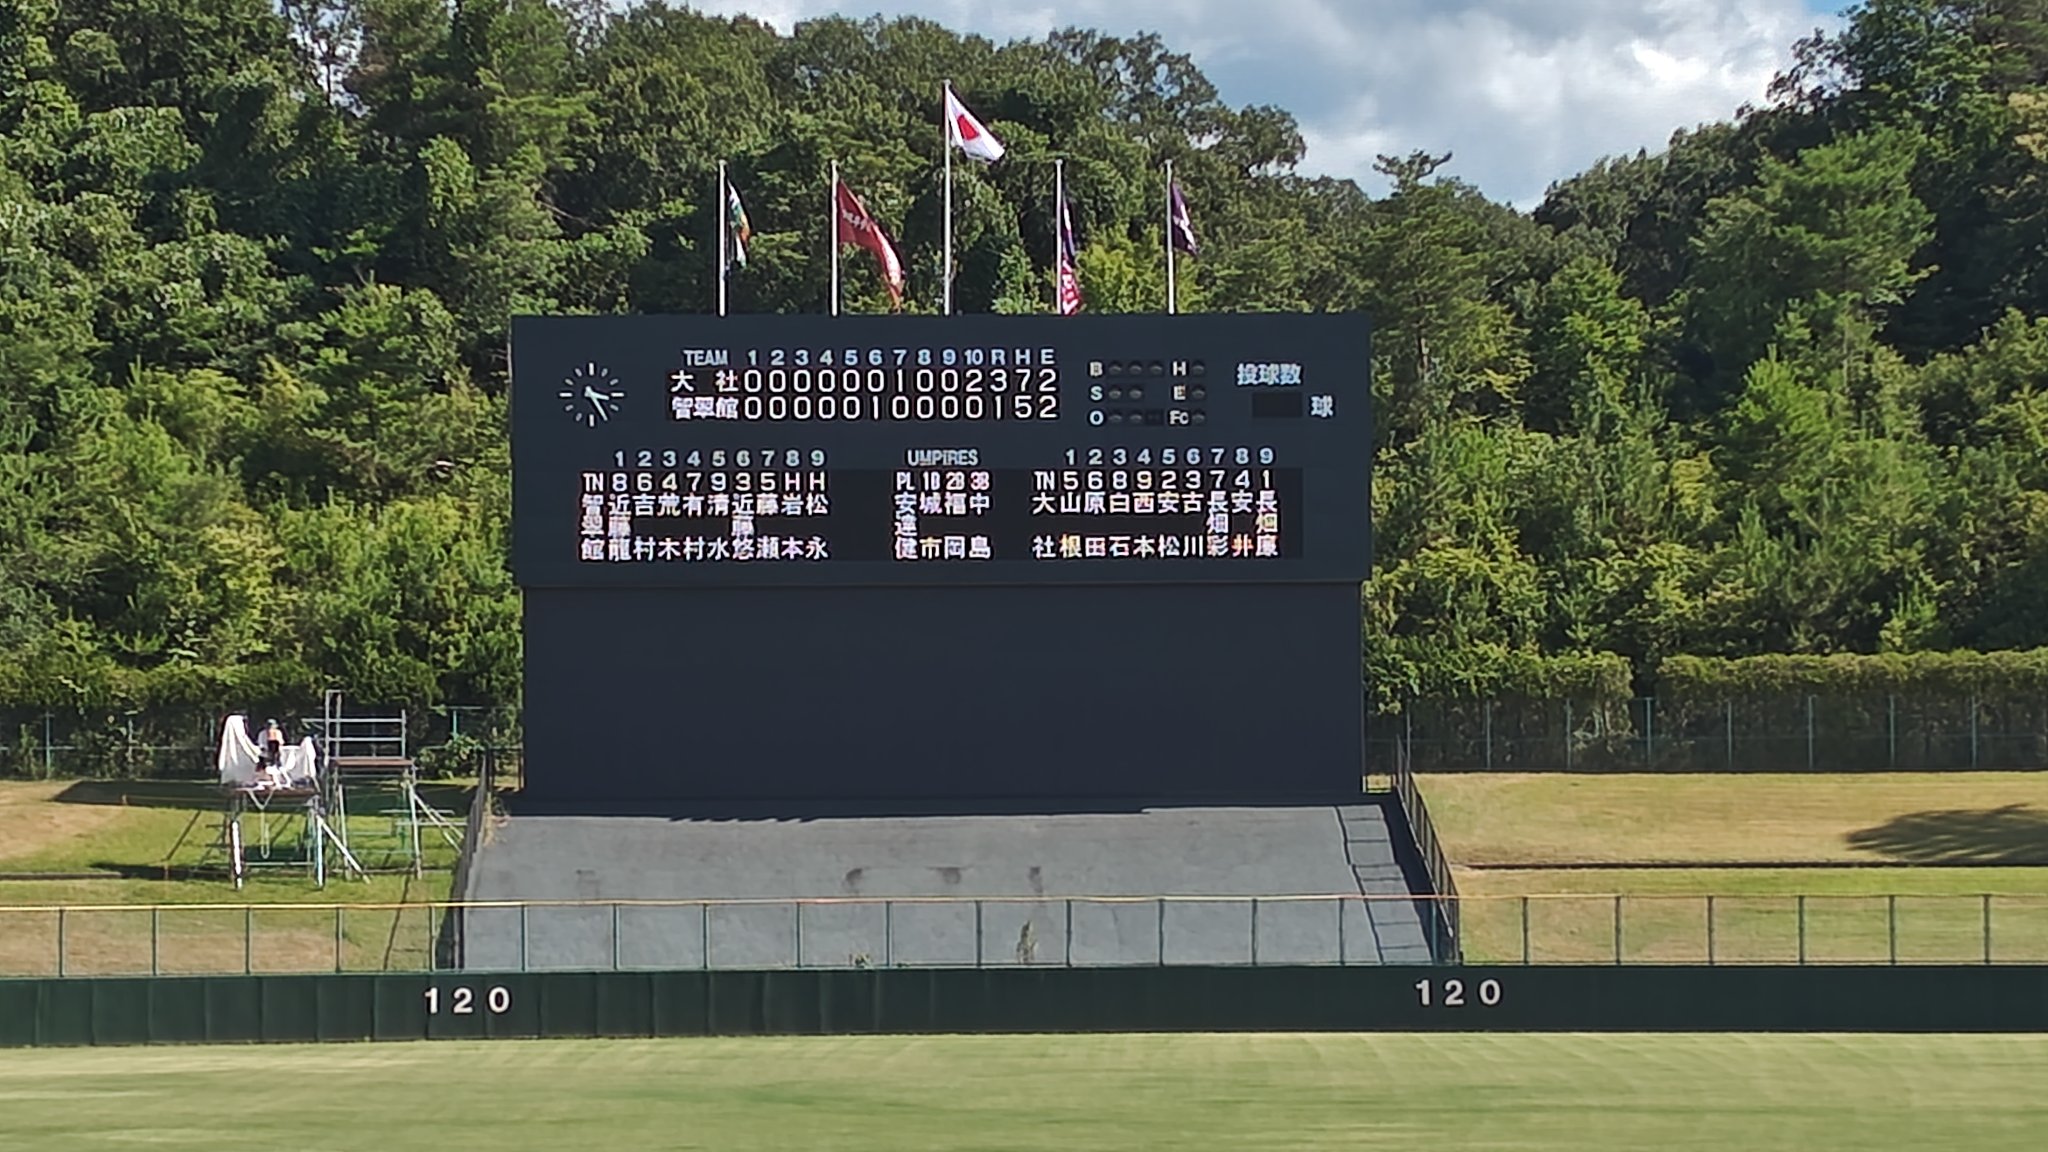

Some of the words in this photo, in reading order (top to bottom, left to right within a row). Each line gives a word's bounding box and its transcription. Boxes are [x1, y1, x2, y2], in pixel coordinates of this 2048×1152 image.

[684, 350, 728, 365] TEAM
[749, 350, 756, 365] 1
[771, 350, 784, 365] 2
[795, 350, 808, 365] 3
[820, 350, 833, 365] 4
[845, 350, 857, 365] 5
[869, 350, 882, 365] 6
[893, 350, 906, 365] 7
[918, 349, 931, 365] 8
[943, 349, 956, 365] 9
[965, 349, 983, 365] 10
[991, 349, 1005, 365] R
[1015, 349, 1030, 365] H
[1041, 349, 1054, 364] E
[1090, 362, 1102, 376] B
[1173, 362, 1186, 375] H
[1237, 363, 1301, 385] 投球数
[671, 370, 738, 392] 大社
[745, 370, 761, 392] 0
[769, 370, 786, 392] 0
[794, 370, 810, 392] 0
[819, 370, 835, 392] 0
[843, 370, 860, 392] 0
[868, 370, 884, 392] 0
[897, 369, 902, 392] 1
[917, 369, 933, 392] 0
[941, 369, 958, 392] 0
[966, 369, 982, 392] 2
[990, 369, 1007, 391] 3
[1016, 369, 1030, 391] 7
[1039, 369, 1056, 391] 2
[1091, 386, 1102, 400] S
[1174, 386, 1185, 400] E
[745, 397, 761, 419] 0
[770, 397, 786, 419] 0
[794, 396, 811, 419] 0
[819, 396, 835, 418] 0
[843, 396, 860, 418] 0
[873, 396, 878, 419] 1
[892, 396, 909, 418] 0
[917, 396, 933, 418] 0
[942, 396, 958, 418] 0
[966, 396, 982, 418] 0
[995, 396, 1001, 419] 1
[1015, 396, 1031, 418] 5
[1040, 395, 1057, 417] 2
[1311, 396, 1333, 417] 球
[616, 451, 623, 467] 1
[638, 451, 651, 466] 2
[663, 451, 676, 466] 3
[687, 451, 700, 466] 4
[713, 451, 725, 466] 5
[737, 451, 750, 466] 6
[762, 451, 774, 466] 7
[786, 450, 799, 466] 8
[811, 450, 824, 466] 9
[1066, 449, 1074, 465] 1
[1089, 449, 1102, 464] 2
[1113, 449, 1126, 465] 3
[1138, 449, 1150, 464] 4
[1163, 449, 1175, 464] 5
[1187, 448, 1200, 464] 6
[1211, 448, 1224, 464] 7
[1236, 448, 1248, 464] 8
[1260, 448, 1273, 464] 9
[613, 473, 627, 491] 8
[638, 473, 652, 491] 6
[662, 473, 677, 490] 4
[687, 473, 701, 491] 7
[711, 473, 726, 491] 9
[736, 473, 750, 491] 3
[761, 473, 775, 491] 5
[785, 472, 800, 491] H
[810, 472, 825, 491] H
[897, 472, 915, 490] PL
[1064, 471, 1078, 489] 5
[1088, 471, 1102, 489] 6
[1113, 471, 1127, 489] 8
[1137, 471, 1152, 489] 9
[1162, 471, 1176, 489] 2
[1186, 470, 1200, 488] 3
[1210, 470, 1225, 488] 7
[1235, 470, 1250, 488] 4
[1263, 470, 1269, 488] 1
[425, 987, 510, 1014] 120
[1415, 979, 1501, 1006] 120
